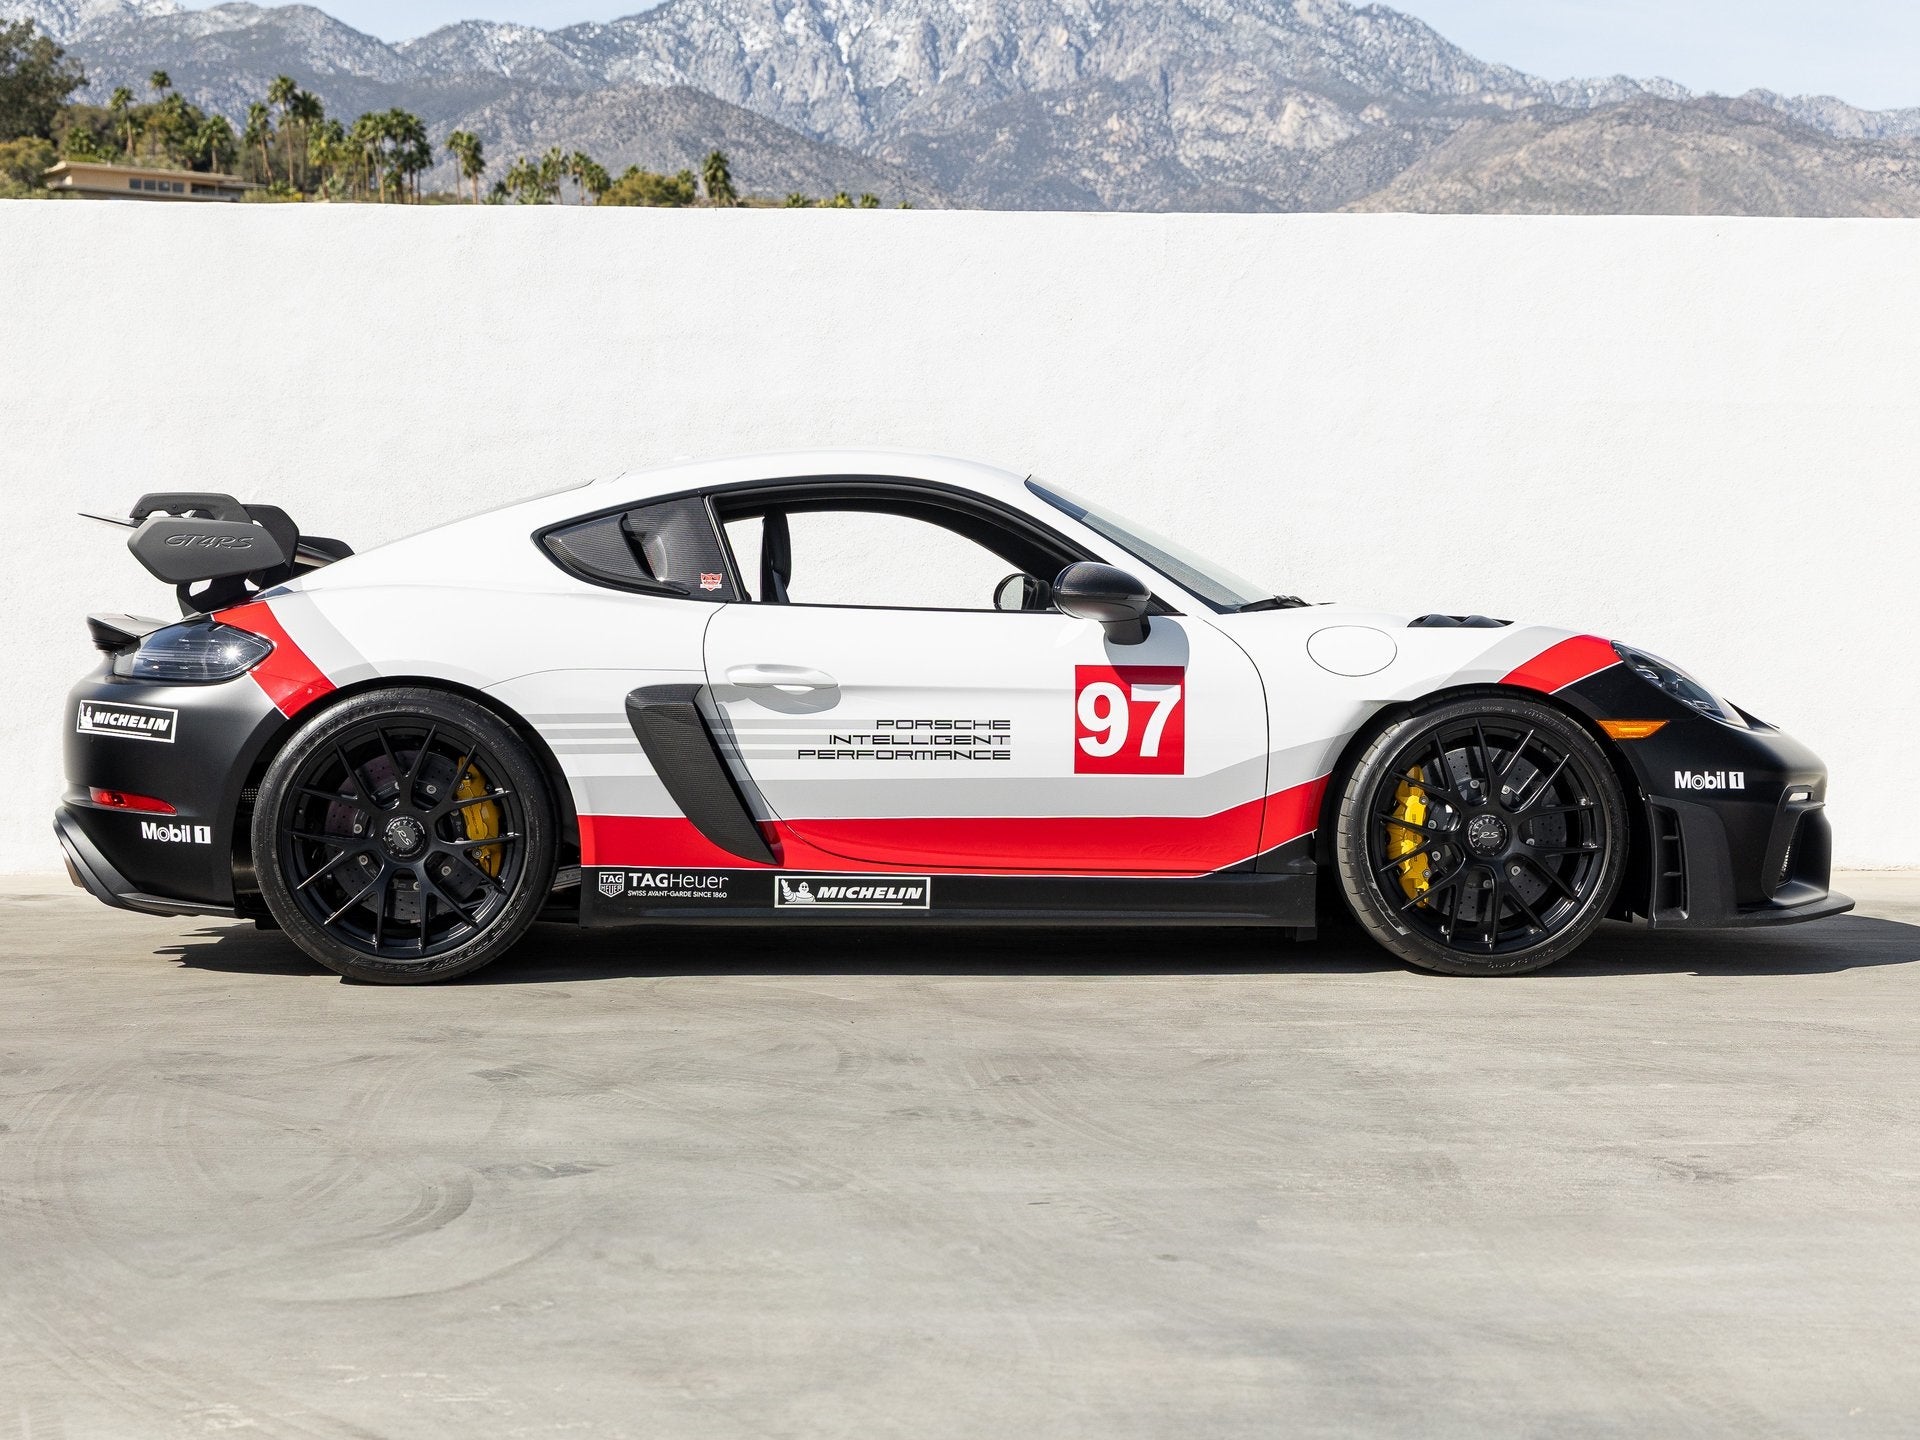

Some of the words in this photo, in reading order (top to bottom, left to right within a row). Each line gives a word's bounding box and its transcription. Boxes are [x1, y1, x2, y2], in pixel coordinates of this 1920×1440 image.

[93, 711, 170, 731] MICHELIN
[1077, 682, 1181, 757] 97
[876, 720, 1010, 730] PORSCHE
[829, 735, 1010, 745] INTELLIGENT
[798, 750, 1010, 760] PERFORMANCE
[1674, 771, 1726, 789] Mobil
[141, 821, 191, 843] Mobil
[601, 874, 623, 883] TAG
[601, 884, 622, 894] HEUER
[816, 886, 923, 900] MICHELIN
[648, 890, 692, 898] AVANT-GARDE
[712, 891, 727, 899] 1860
